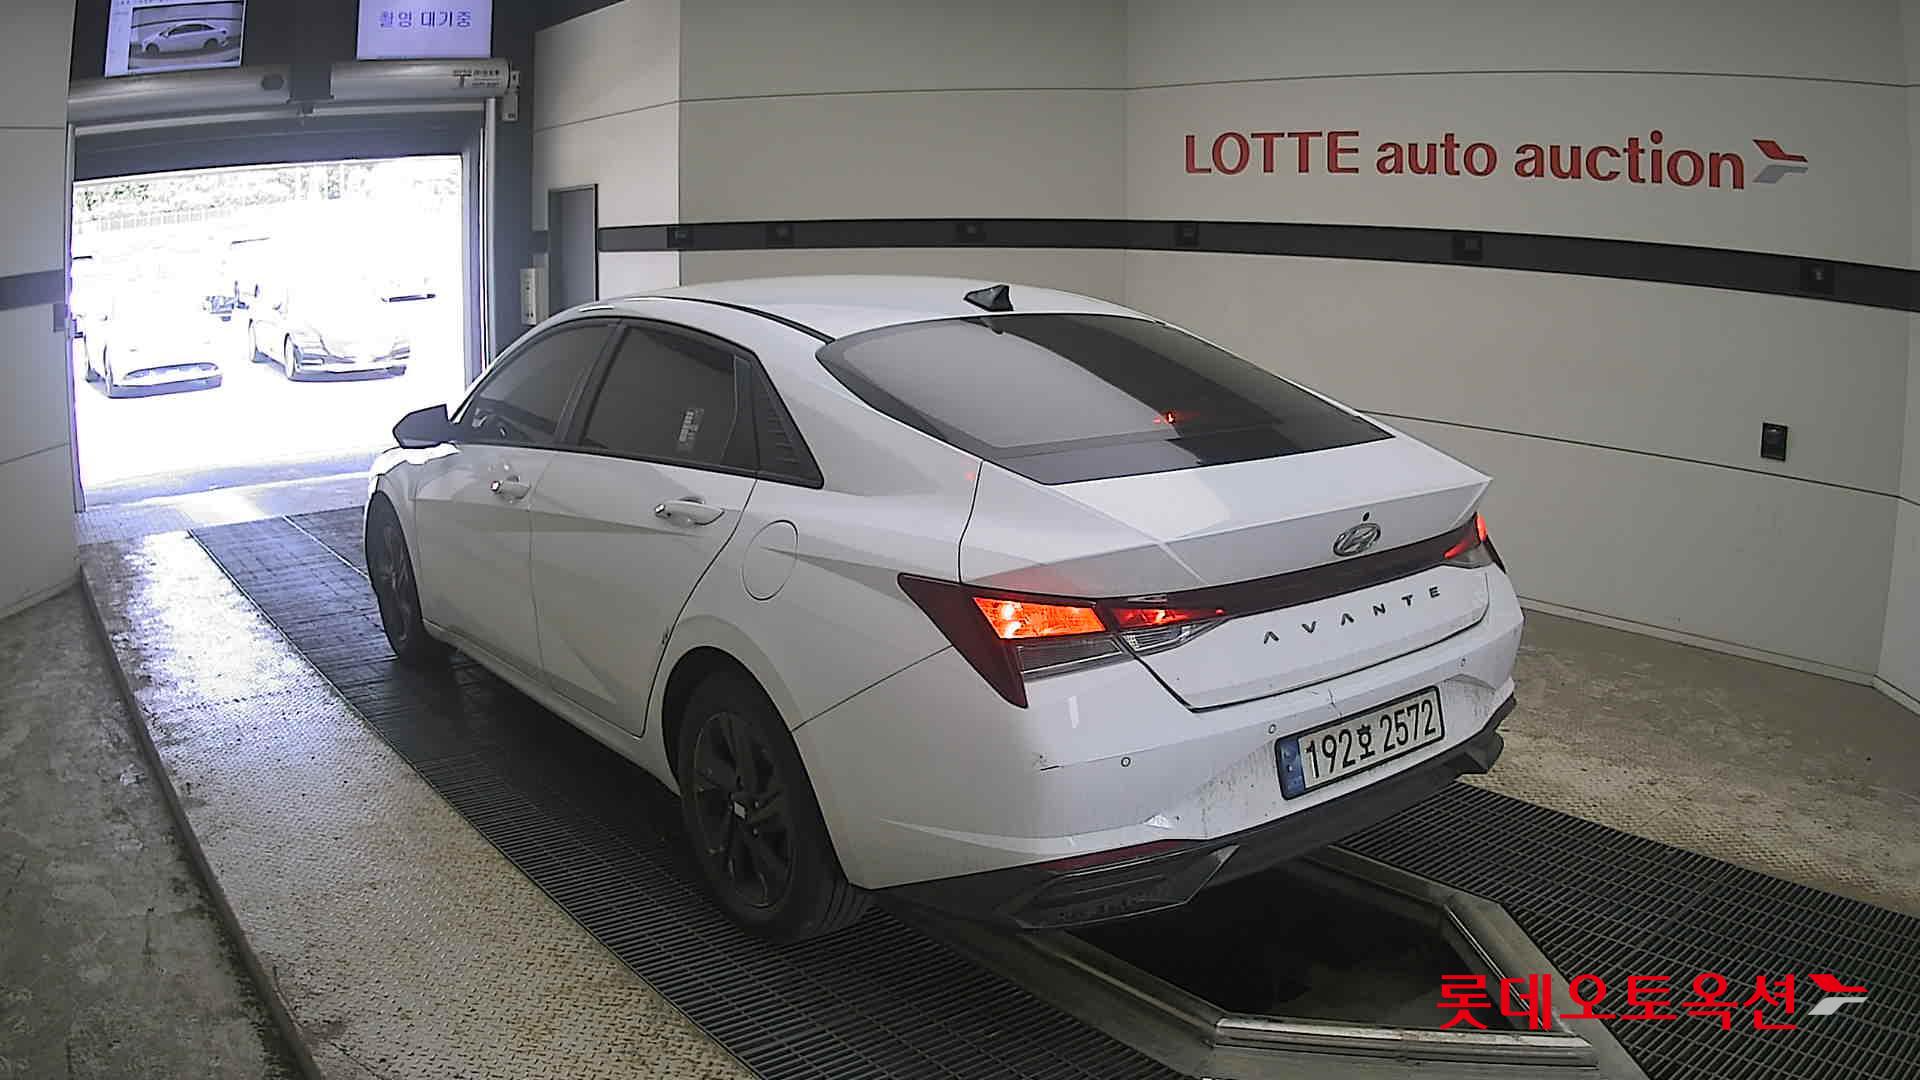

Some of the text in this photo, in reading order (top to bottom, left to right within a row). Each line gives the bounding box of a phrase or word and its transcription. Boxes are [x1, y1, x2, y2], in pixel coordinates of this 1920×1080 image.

[1184, 131, 1745, 189] LOTTE auto auction
[1263, 586, 1440, 644] AVANTE
[1379, 699, 1436, 753] 2572
